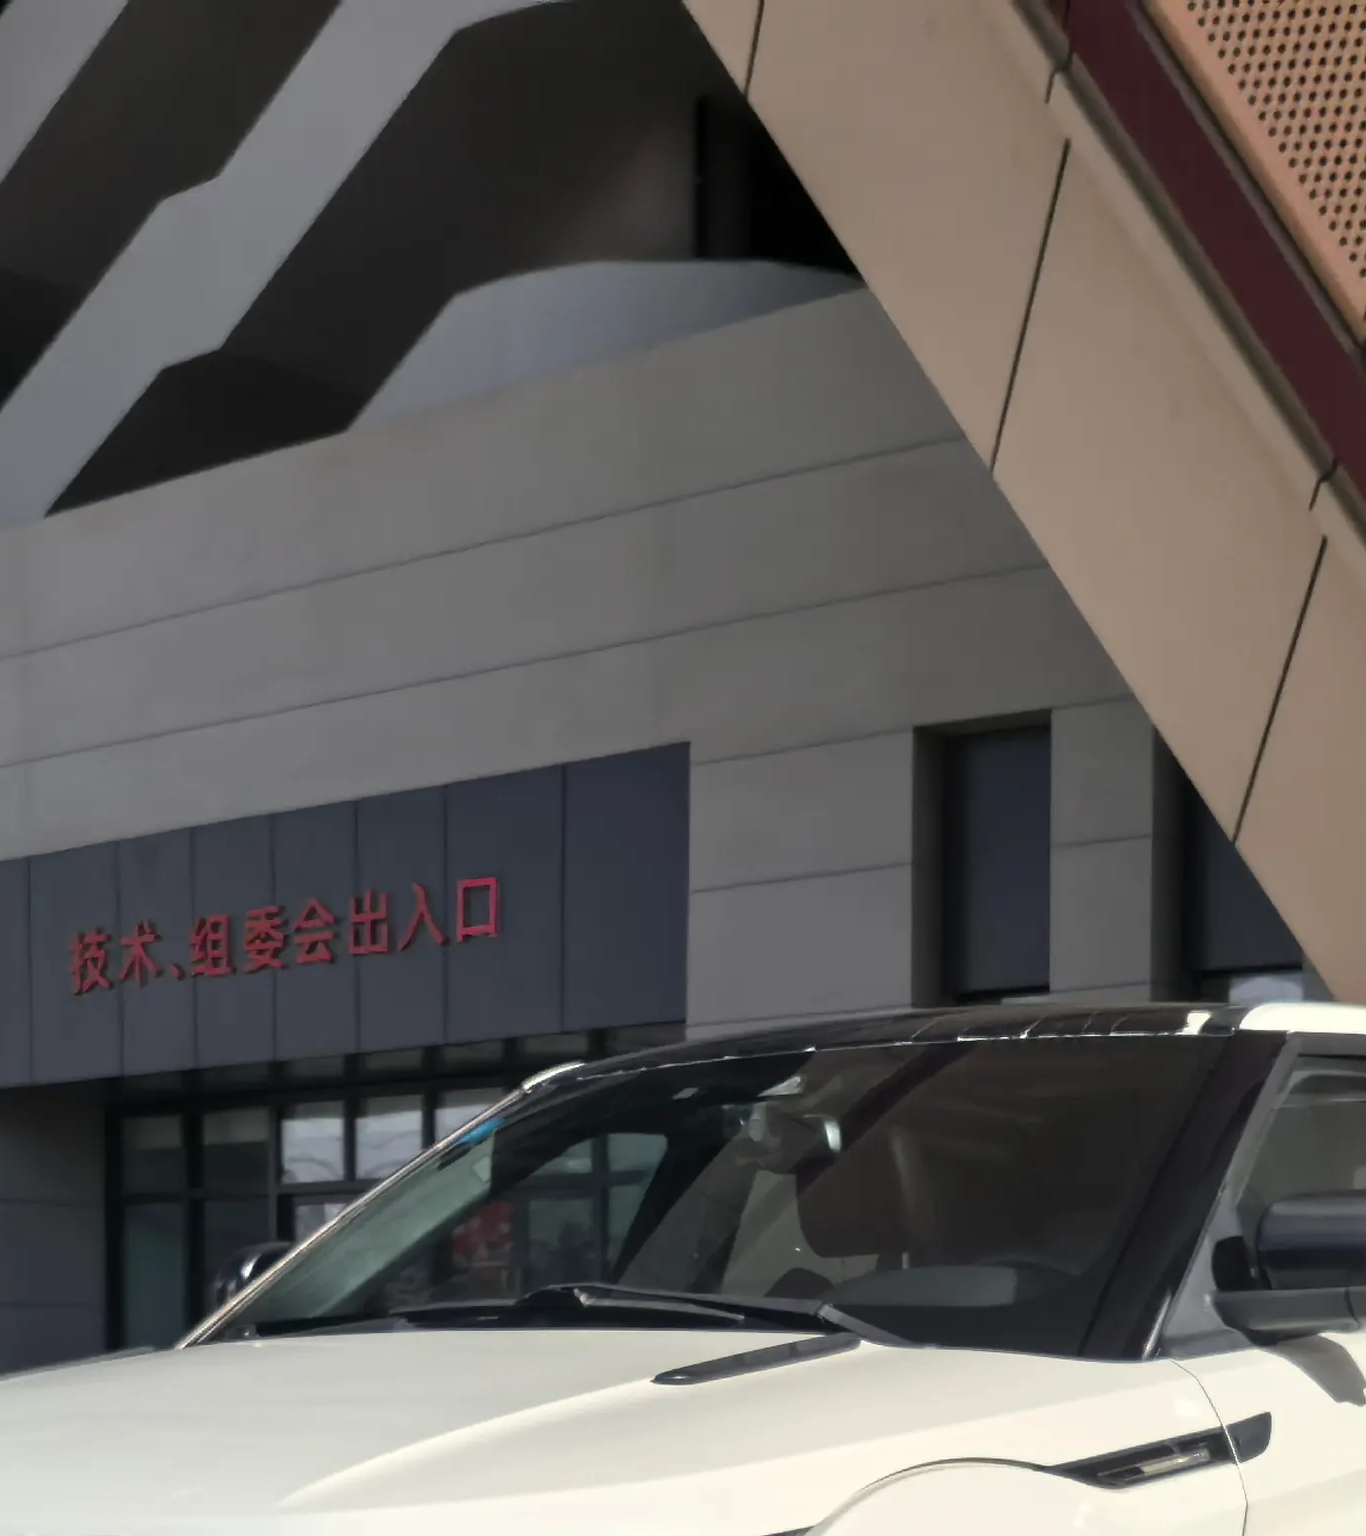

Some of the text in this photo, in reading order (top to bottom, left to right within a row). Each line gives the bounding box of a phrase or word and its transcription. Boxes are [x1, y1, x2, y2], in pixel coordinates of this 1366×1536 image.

[69, 876, 501, 995] 技术、组委会出入口
